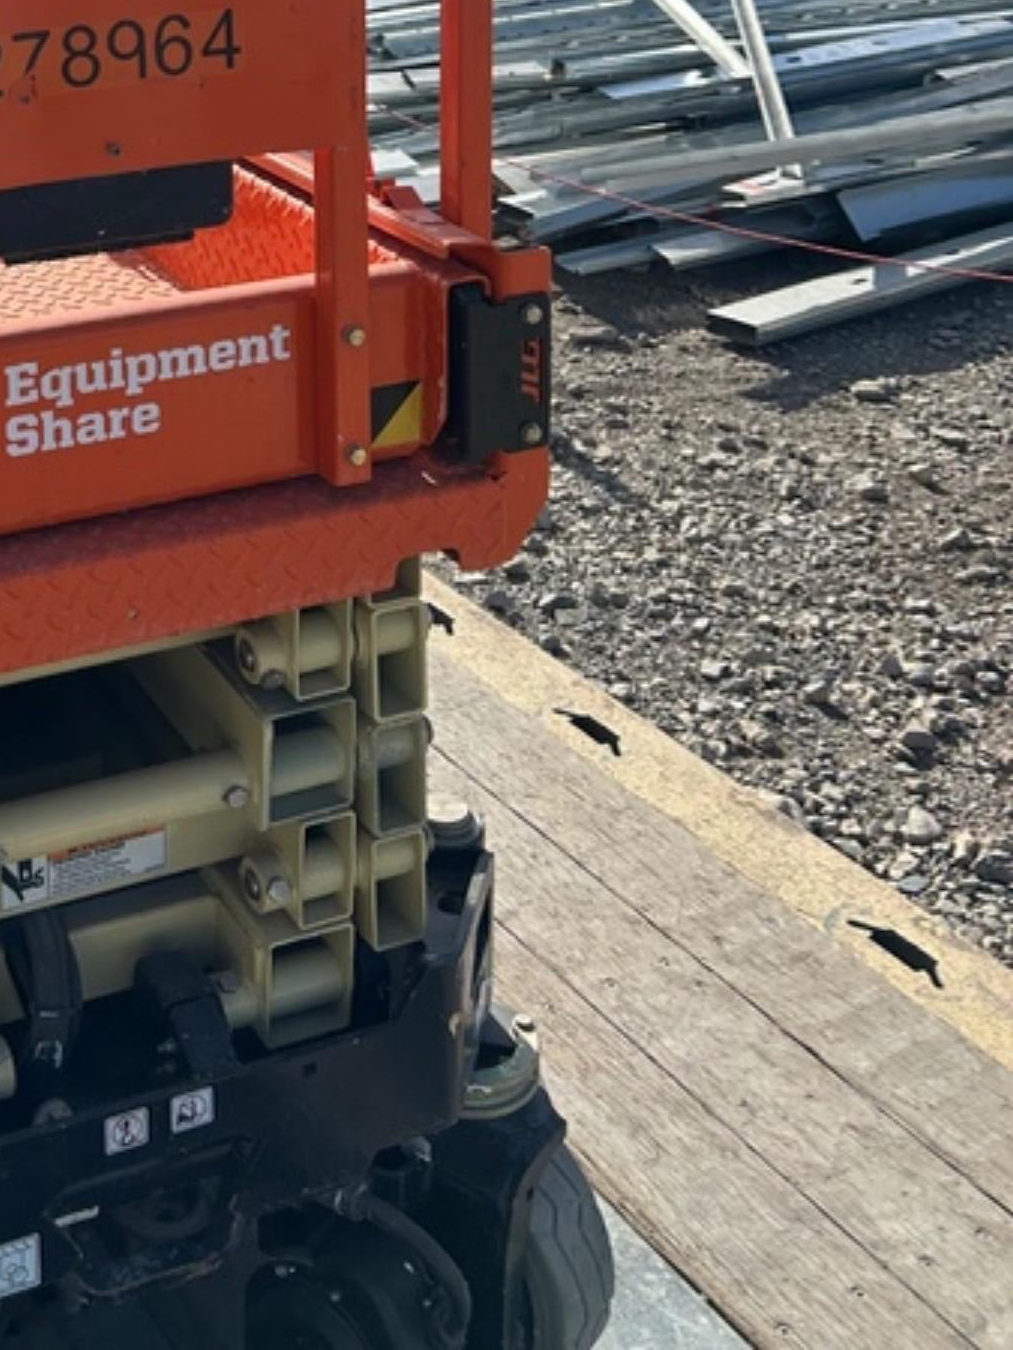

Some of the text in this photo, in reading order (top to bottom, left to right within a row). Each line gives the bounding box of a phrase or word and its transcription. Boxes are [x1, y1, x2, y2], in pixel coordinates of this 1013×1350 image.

[4, 324, 291, 408] Equipment
[520, 337, 542, 404] JLG
[5, 401, 161, 458] Share
